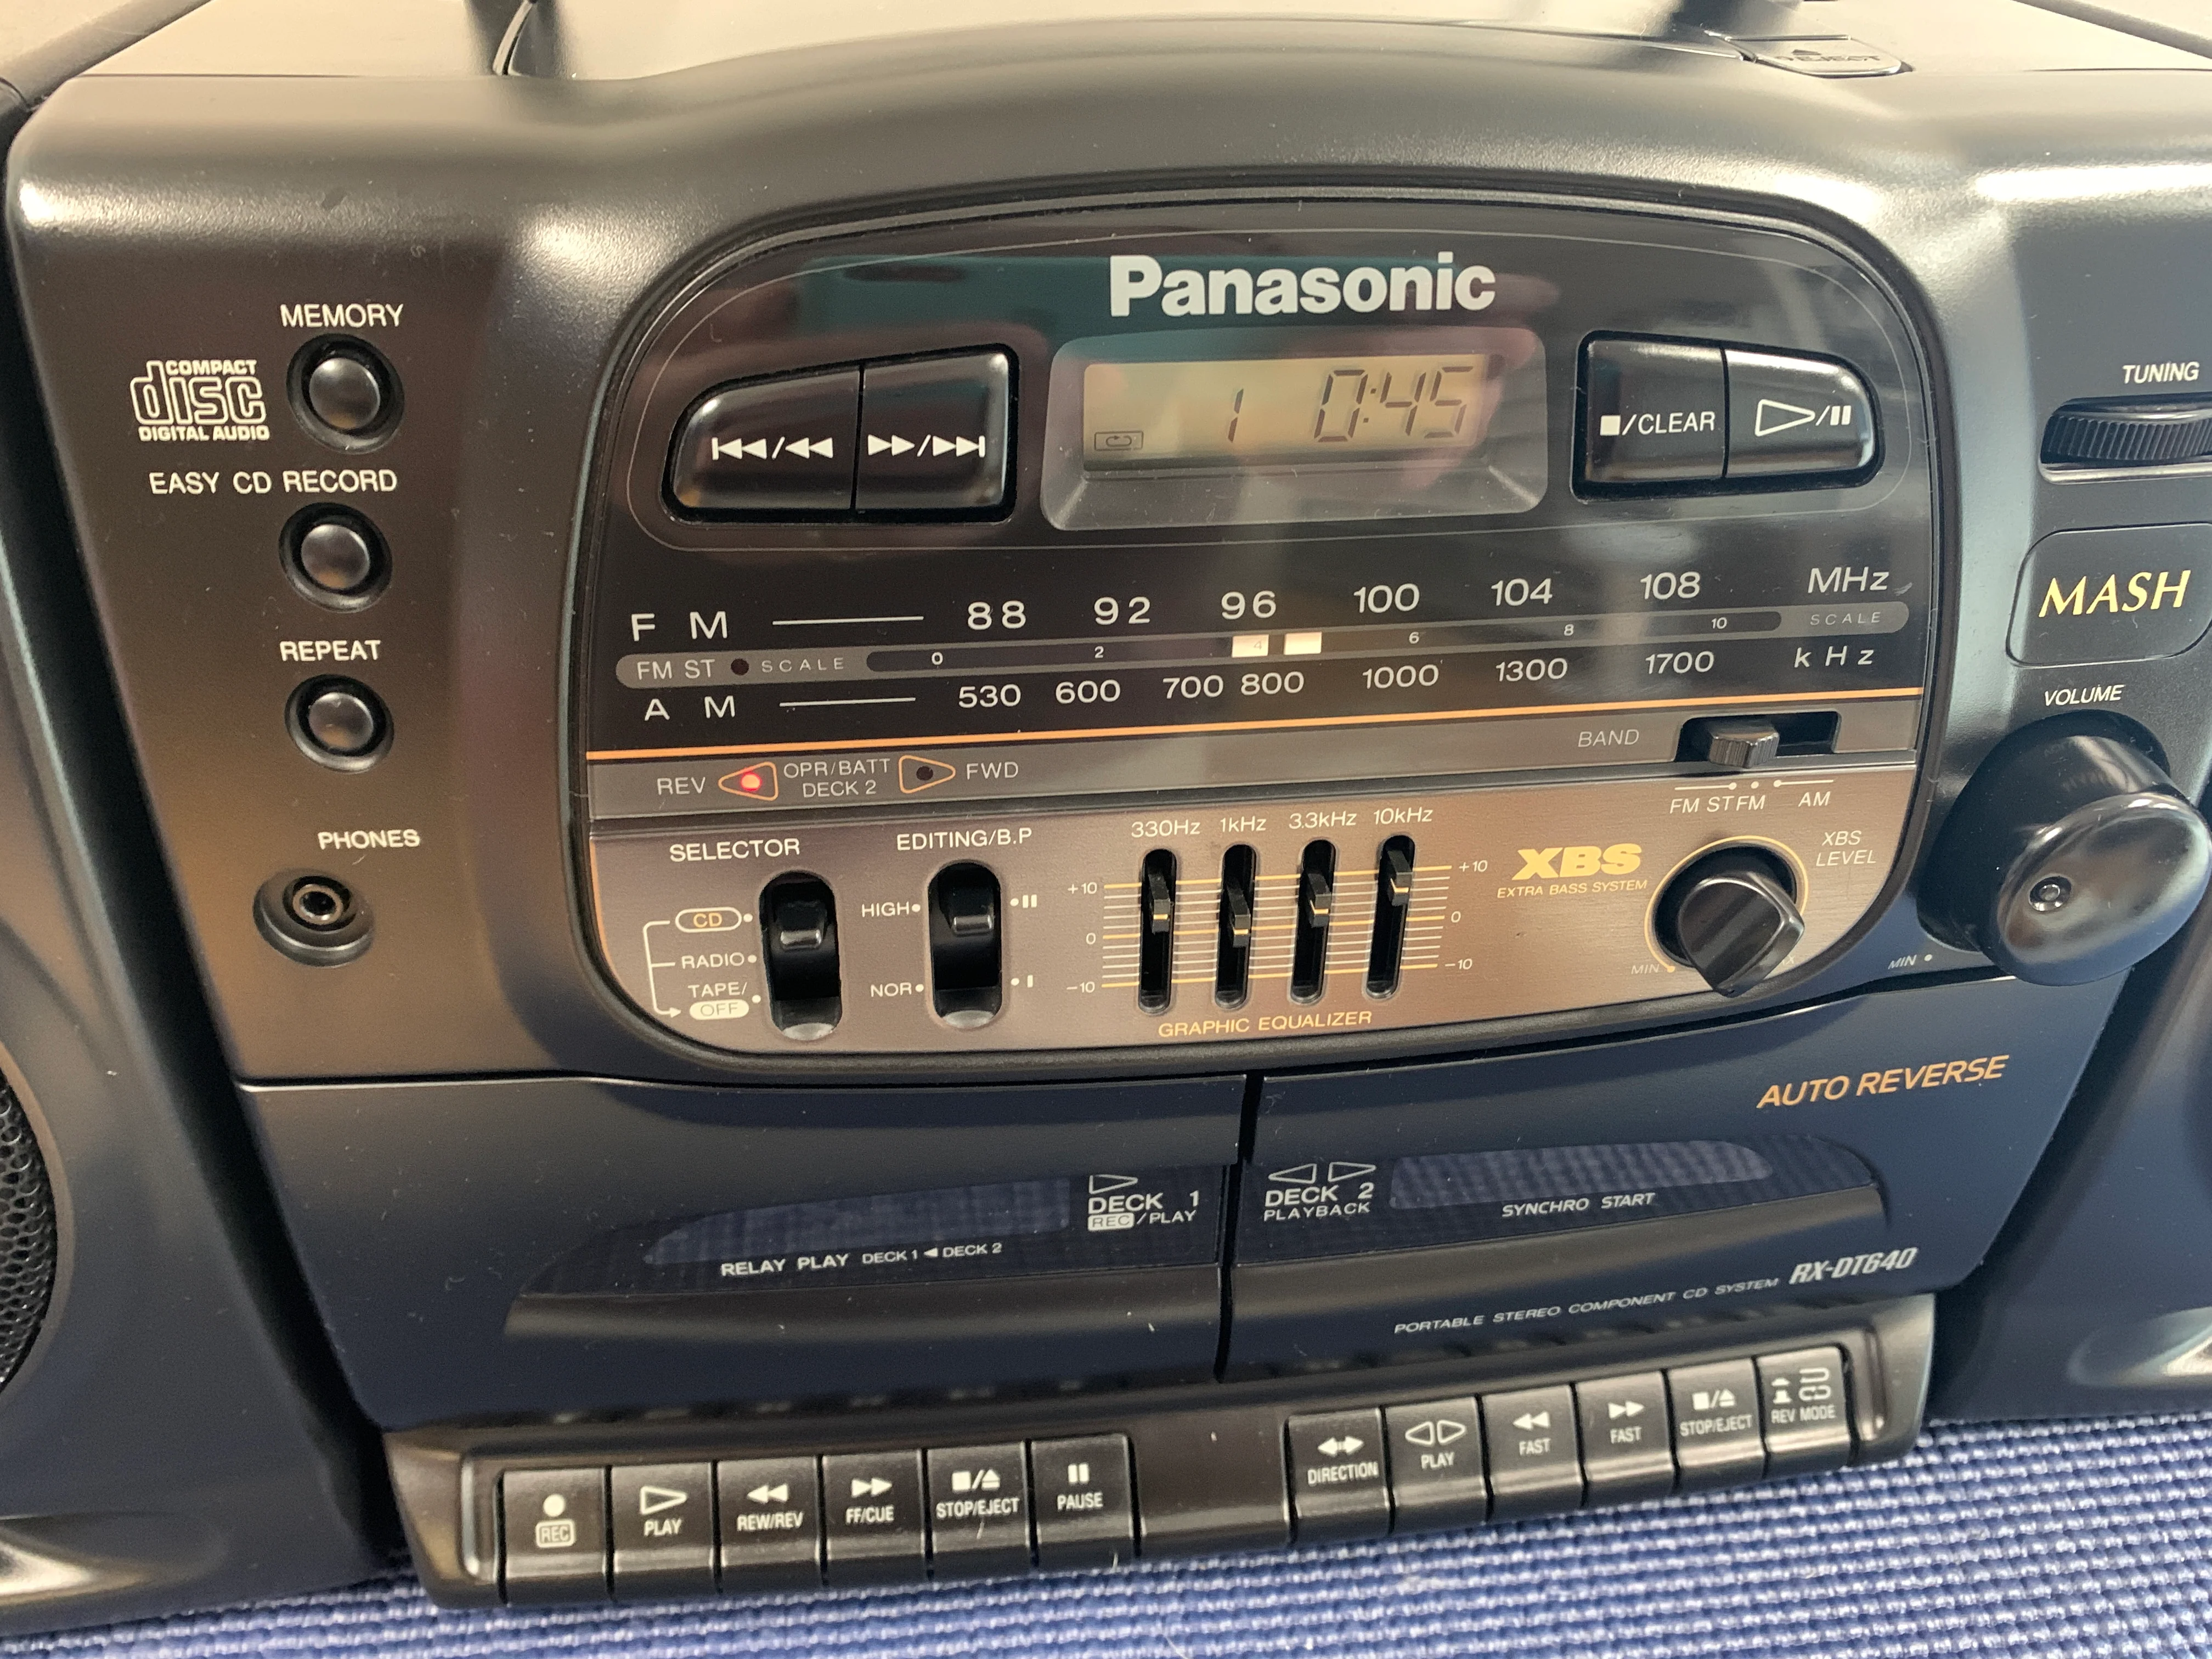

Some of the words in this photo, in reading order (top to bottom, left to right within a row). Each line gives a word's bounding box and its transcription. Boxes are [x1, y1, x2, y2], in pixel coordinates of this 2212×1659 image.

[1109, 251, 1496, 318] Panasonic
[280, 303, 403, 328] MEMORY
[165, 359, 257, 375] COMPACT
[2123, 361, 2199, 383] TUNING
[129, 360, 267, 425] disc
[1227, 388, 1244, 443] 1
[1313, 365, 1474, 442] 0:45
[138, 425, 209, 442] DIGITAL
[212, 425, 270, 441] AUDIO
[149, 471, 220, 494] EASY
[233, 470, 272, 494] CD
[283, 469, 398, 493] RECORD
[1640, 571, 1701, 601] 108
[1807, 566, 1889, 594] MHz
[1353, 583, 1420, 613] 100
[1491, 577, 1553, 606] 104
[2038, 569, 2191, 618] MASH
[967, 600, 1026, 630] 88
[1093, 596, 1151, 625] 92
[1221, 590, 1277, 620] 96
[1711, 617, 1728, 630] 10
[1810, 611, 1881, 627] SCALE
[1408, 631, 1420, 645] 6
[1564, 624, 1575, 636] 8
[280, 639, 381, 661] REPEAT
[1094, 646, 1104, 659] 2
[1254, 640, 1262, 650] 4
[761, 657, 845, 673] SCALE
[931, 652, 944, 665] 0
[1645, 651, 1715, 674] 1700
[637, 661, 673, 680] FM
[684, 659, 715, 679] ST
[1362, 664, 1439, 689] 1000
[1496, 657, 1568, 682] 1300
[1054, 679, 1121, 704] 600
[1163, 674, 1224, 700] 700
[1240, 671, 1305, 696] 800
[958, 683, 1022, 709] 530
[2044, 684, 2125, 707] VOLUME
[1578, 729, 1640, 748] BAND
[783, 758, 891, 777] OPR/BATT
[966, 761, 1019, 780] FWD
[657, 777, 706, 795] REV
[803, 781, 860, 798] DECK
[865, 781, 877, 795] 2
[1669, 797, 1700, 814] FM
[1706, 795, 1735, 813] ST
[1736, 794, 1766, 811] FM
[1798, 791, 1831, 808] AM
[1220, 816, 1267, 833] 1kHz
[1289, 810, 1357, 830] 3.3kHz
[1373, 806, 1434, 825] 10kHz
[896, 827, 1032, 851] EDITING/B.P
[1131, 819, 1201, 839] 330Hz
[1821, 830, 1863, 846] XBS
[318, 829, 420, 850] PHONES
[669, 838, 800, 863] SELECTOR
[1815, 849, 1877, 867] LEVEL
[1459, 860, 1488, 872] +10
[1511, 843, 1642, 881] XBS
[1068, 882, 1098, 895] +10
[1497, 885, 1543, 899] EXTRA
[1549, 883, 1587, 895] BASS
[1592, 879, 1647, 893] SYSTEM
[861, 901, 910, 918] HIGH
[1451, 911, 1462, 923] 0
[692, 912, 723, 928] CD
[1086, 933, 1097, 945] 0
[681, 952, 745, 970] RADIO
[1444, 958, 1473, 970] -10
[1631, 963, 1660, 975] MIN
[1888, 955, 1917, 970] MIN
[688, 982, 747, 998] TAPE/
[871, 982, 912, 997] NOR
[1066, 981, 1096, 994] -10
[700, 1002, 740, 1018] OFF
[1158, 1017, 1250, 1038] GRAPHIC
[1258, 1010, 1373, 1031] EQUALIZER
[1756, 1075, 1850, 1109] AUTO
[1855, 1054, 2010, 1097] REVERSE
[1088, 1192, 1164, 1215] DECK
[1189, 1189, 1200, 1207] 1
[1265, 1184, 1340, 1207] DECK
[1357, 1182, 1375, 1199] 2
[1263, 1201, 1370, 1222] PLAYBACK
[1502, 1197, 1589, 1218] SYNCHRO
[1601, 1192, 1656, 1210] START
[721, 1258, 786, 1277] RELAY
[797, 1252, 849, 1271] PLAY
[862, 1250, 907, 1265] DECK
[912, 1249, 918, 1260] 1
[943, 1243, 988, 1259] DECK
[992, 1242, 1003, 1254] 2
[1788, 1246, 1920, 1285] RX-DT640
[1394, 1314, 1485, 1334] PORTABLE
[1492, 1306, 1561, 1324] STEREO
[1568, 1291, 1676, 1314] COMPONENT
[1683, 1287, 1708, 1300] CD
[1714, 1277, 1779, 1296] SYSTEM
[1771, 1408, 1795, 1424] REV
[1799, 1403, 1836, 1421] MODE
[1610, 1426, 1642, 1444] FAST
[1679, 1414, 1753, 1437] STOP/EJECT
[1519, 1437, 1552, 1457] FAST
[1421, 1452, 1455, 1469] PLAY
[1307, 1461, 1379, 1485] DIRECTION
[936, 1497, 1020, 1519] STOP/EJECT
[1057, 1492, 1103, 1511] PAUSE
[736, 1511, 804, 1532] REW/REV
[845, 1505, 895, 1524] FF/CUE
[541, 1525, 570, 1542] REC
[644, 1517, 682, 1537] PLAY
